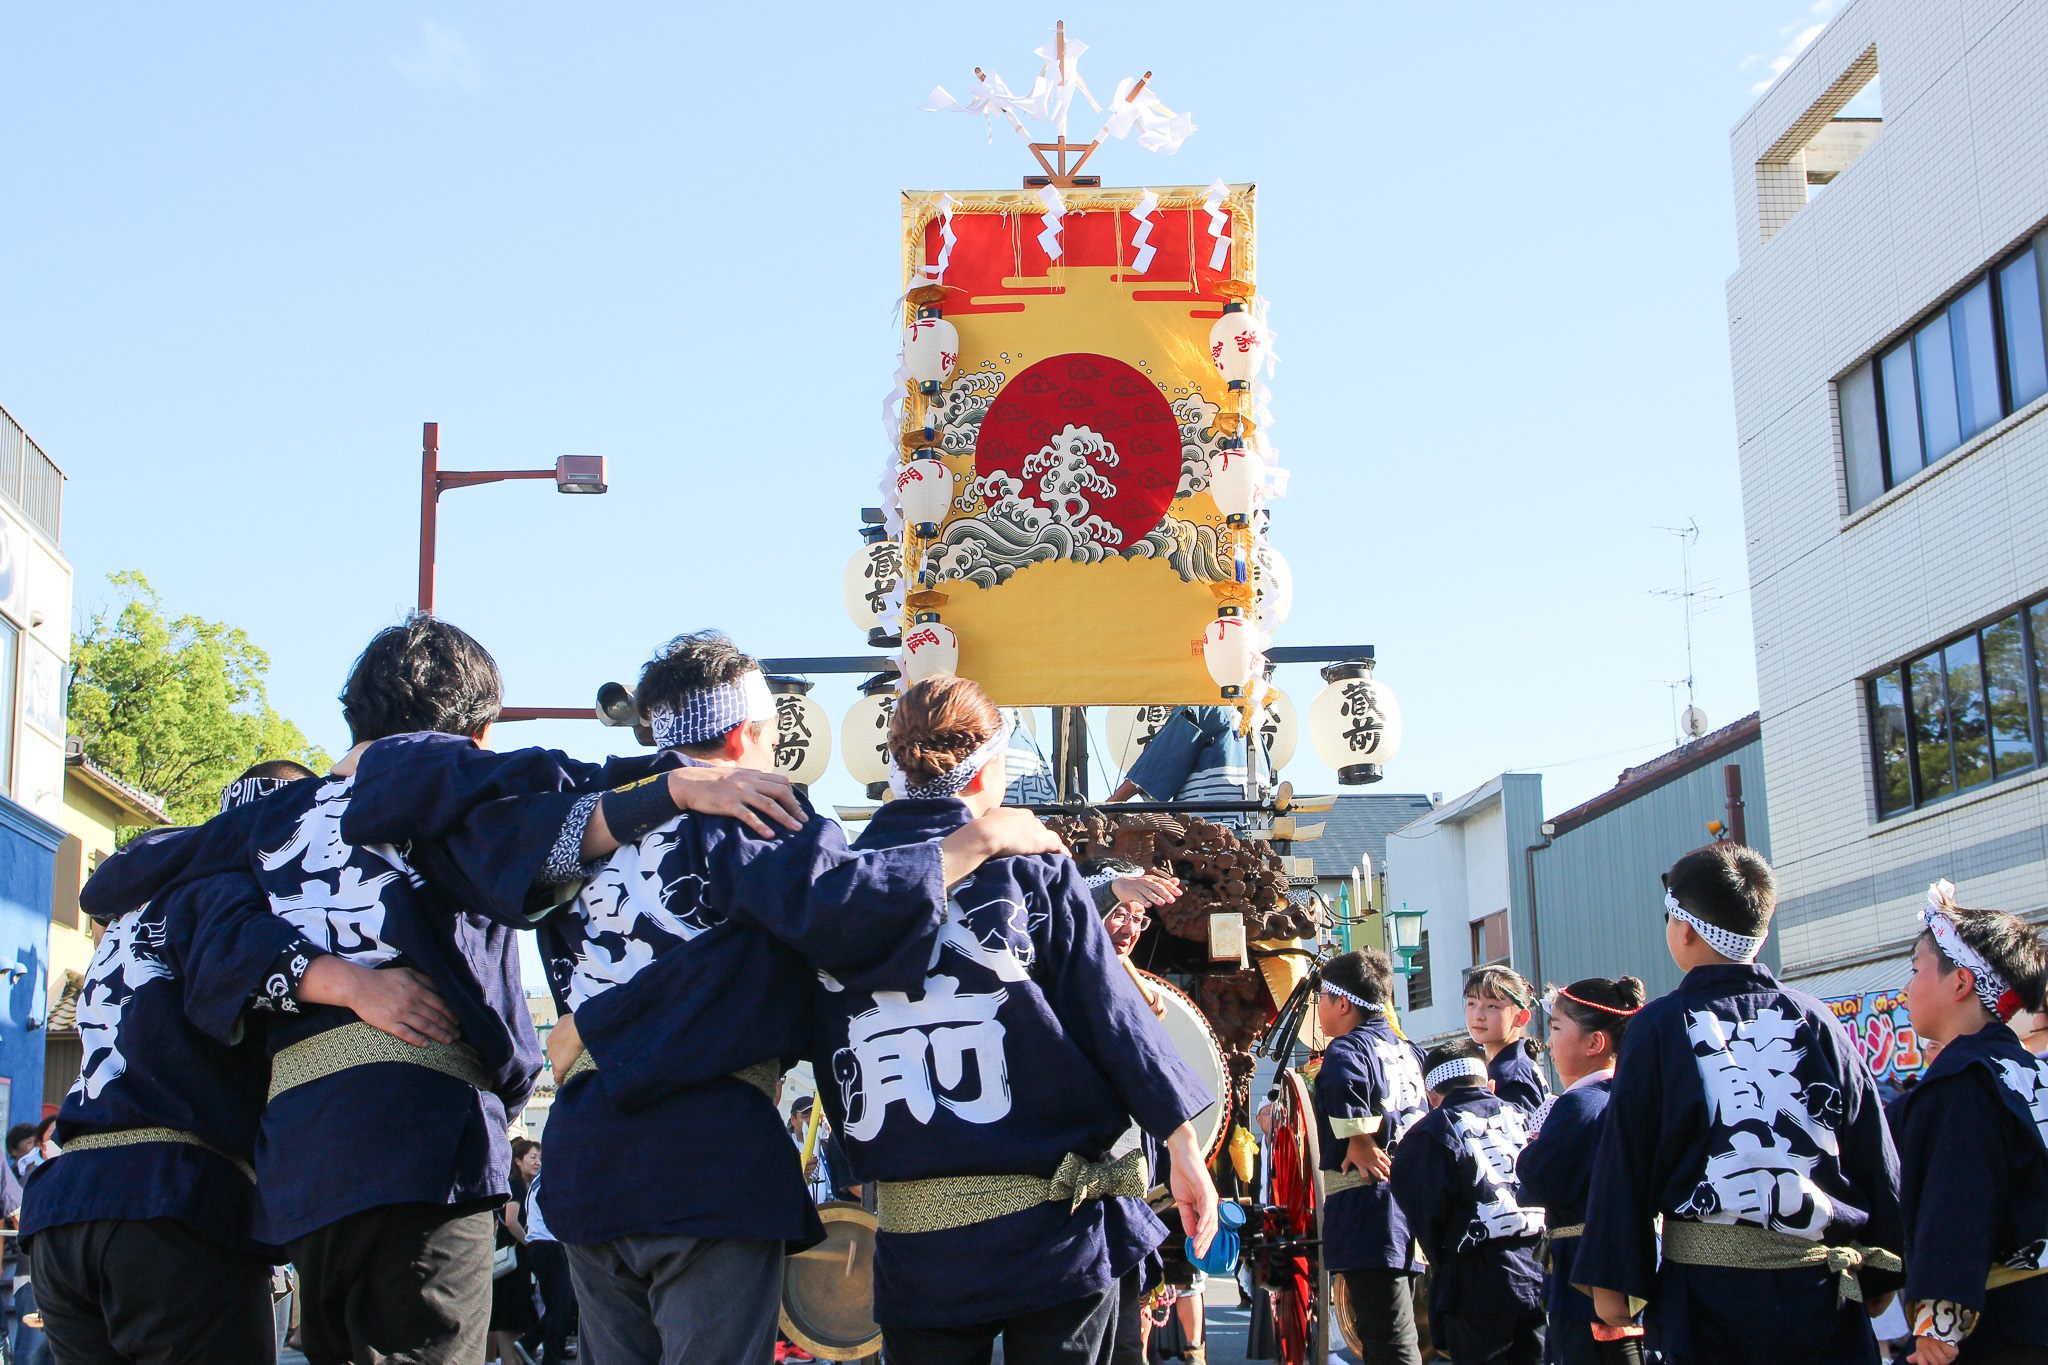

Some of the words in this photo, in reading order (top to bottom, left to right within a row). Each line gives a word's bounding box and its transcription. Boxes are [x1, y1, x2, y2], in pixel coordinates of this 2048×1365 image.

[774, 696, 812, 771] 蔵前
[1341, 681, 1386, 754] 蔵前
[1685, 1005, 1840, 1241] 蔵前
